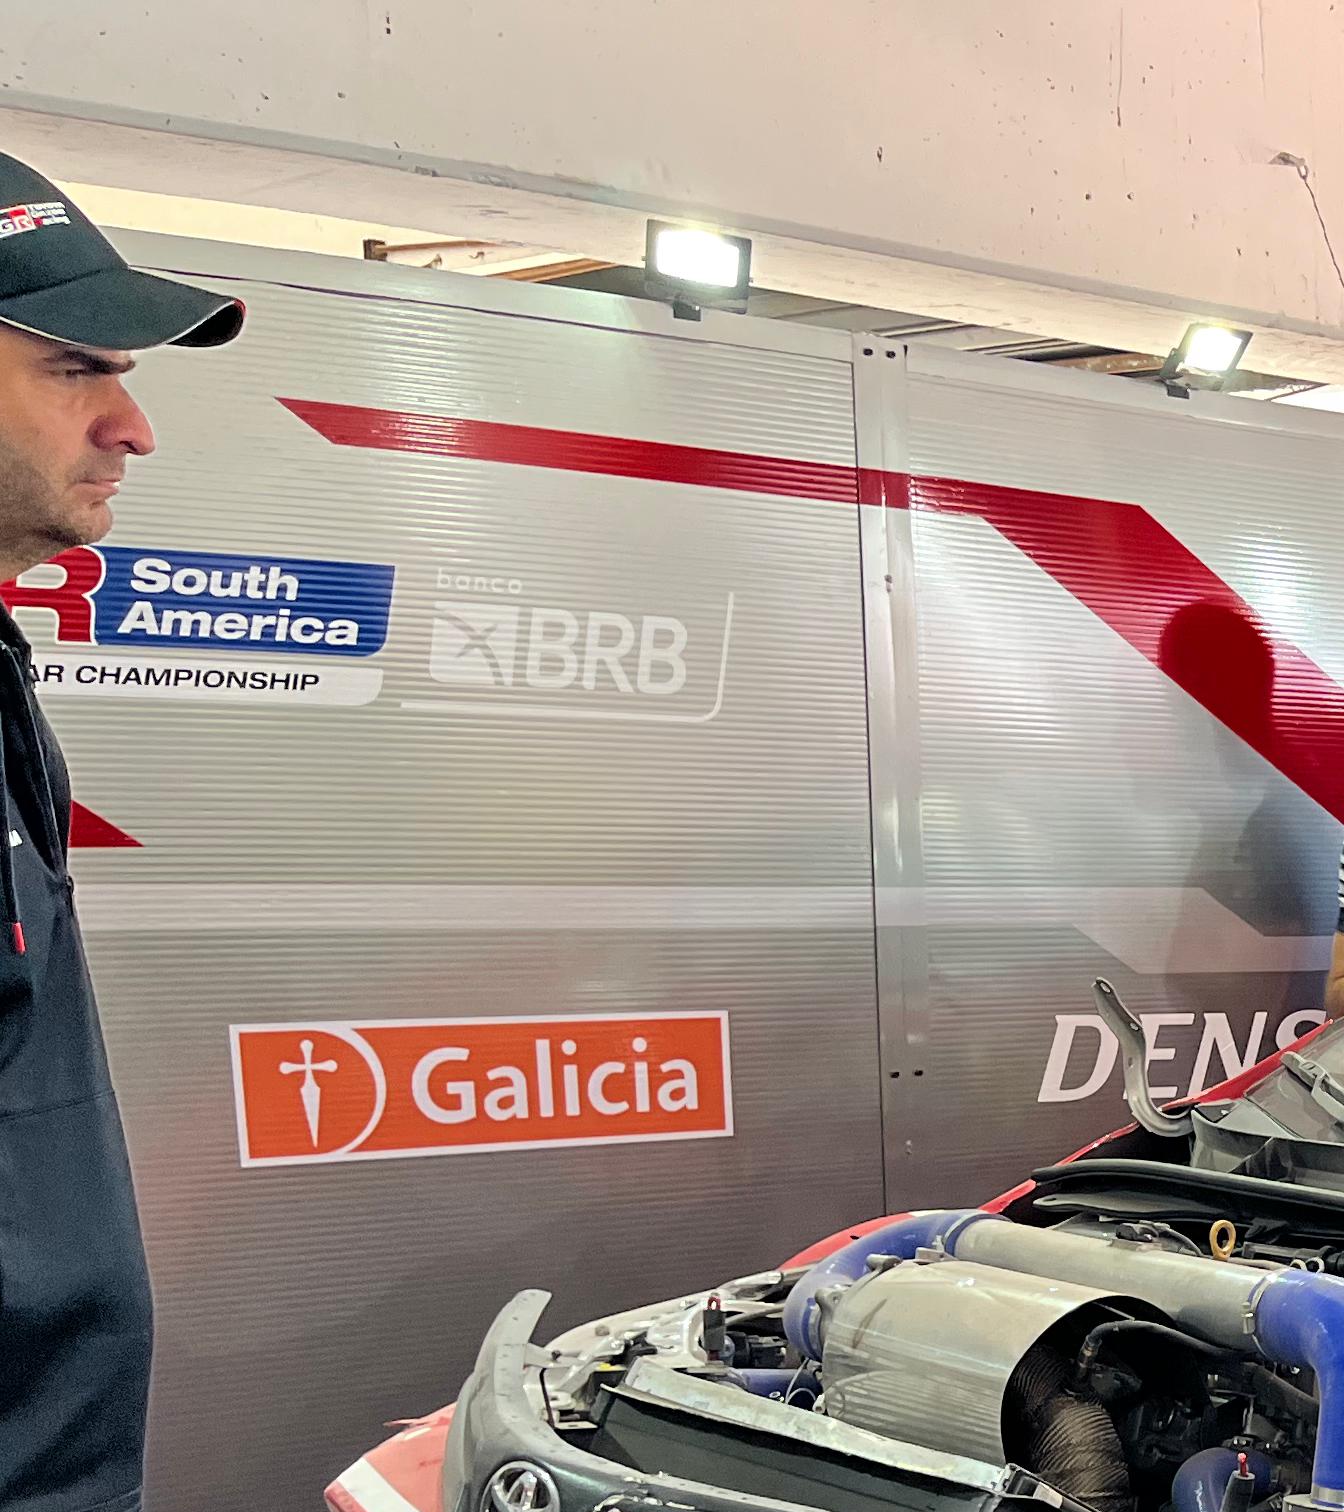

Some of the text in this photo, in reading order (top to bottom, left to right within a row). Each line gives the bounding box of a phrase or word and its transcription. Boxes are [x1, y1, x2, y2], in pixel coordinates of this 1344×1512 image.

[130, 557, 299, 601] South
[436, 567, 522, 594] banco
[117, 601, 358, 646] America
[526, 607, 688, 695] BRB
[76, 665, 319, 691] CHAMPIONSHIP
[411, 1036, 699, 1125] Galicia
